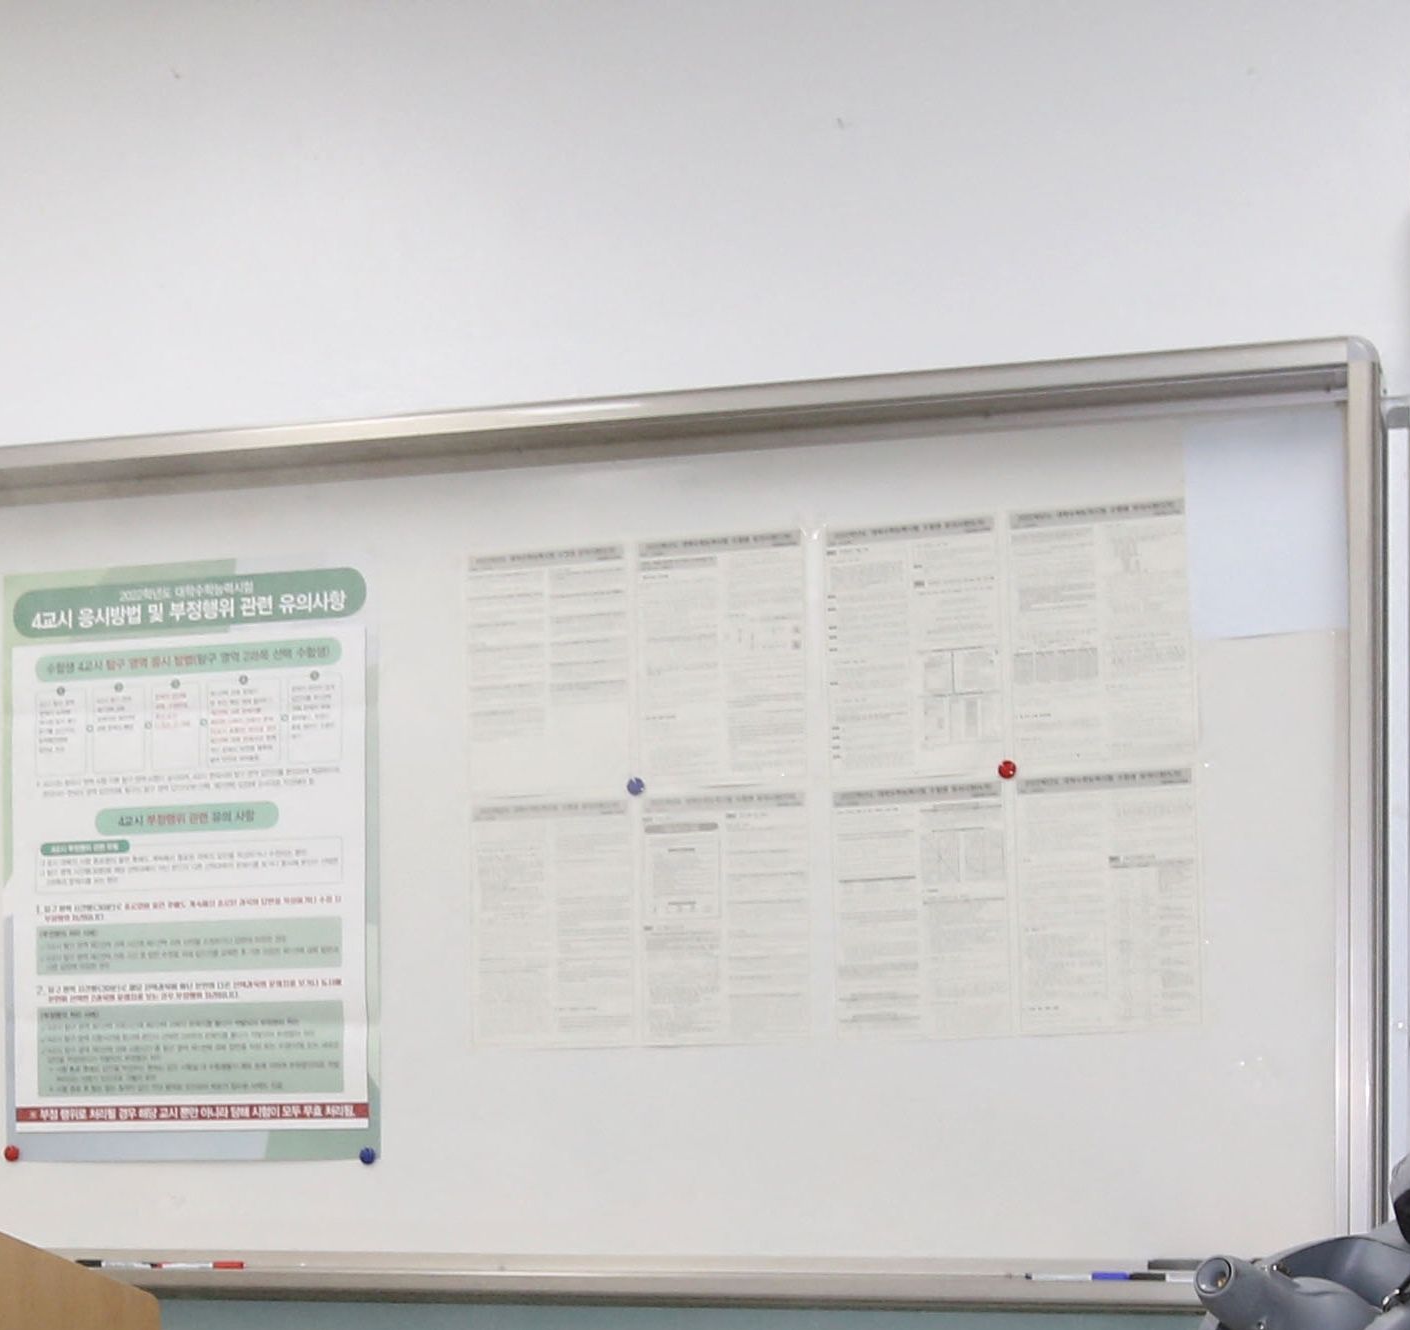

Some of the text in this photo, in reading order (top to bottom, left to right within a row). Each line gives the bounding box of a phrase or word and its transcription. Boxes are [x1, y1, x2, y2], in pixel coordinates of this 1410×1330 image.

[31, 589, 346, 630] 4교시 응시방법 및 부정행위 관련 유의사항
[118, 815, 144, 827] 4교시
[158, 1106, 179, 1120] 교시
[200, 1104, 229, 1119] 아니라
